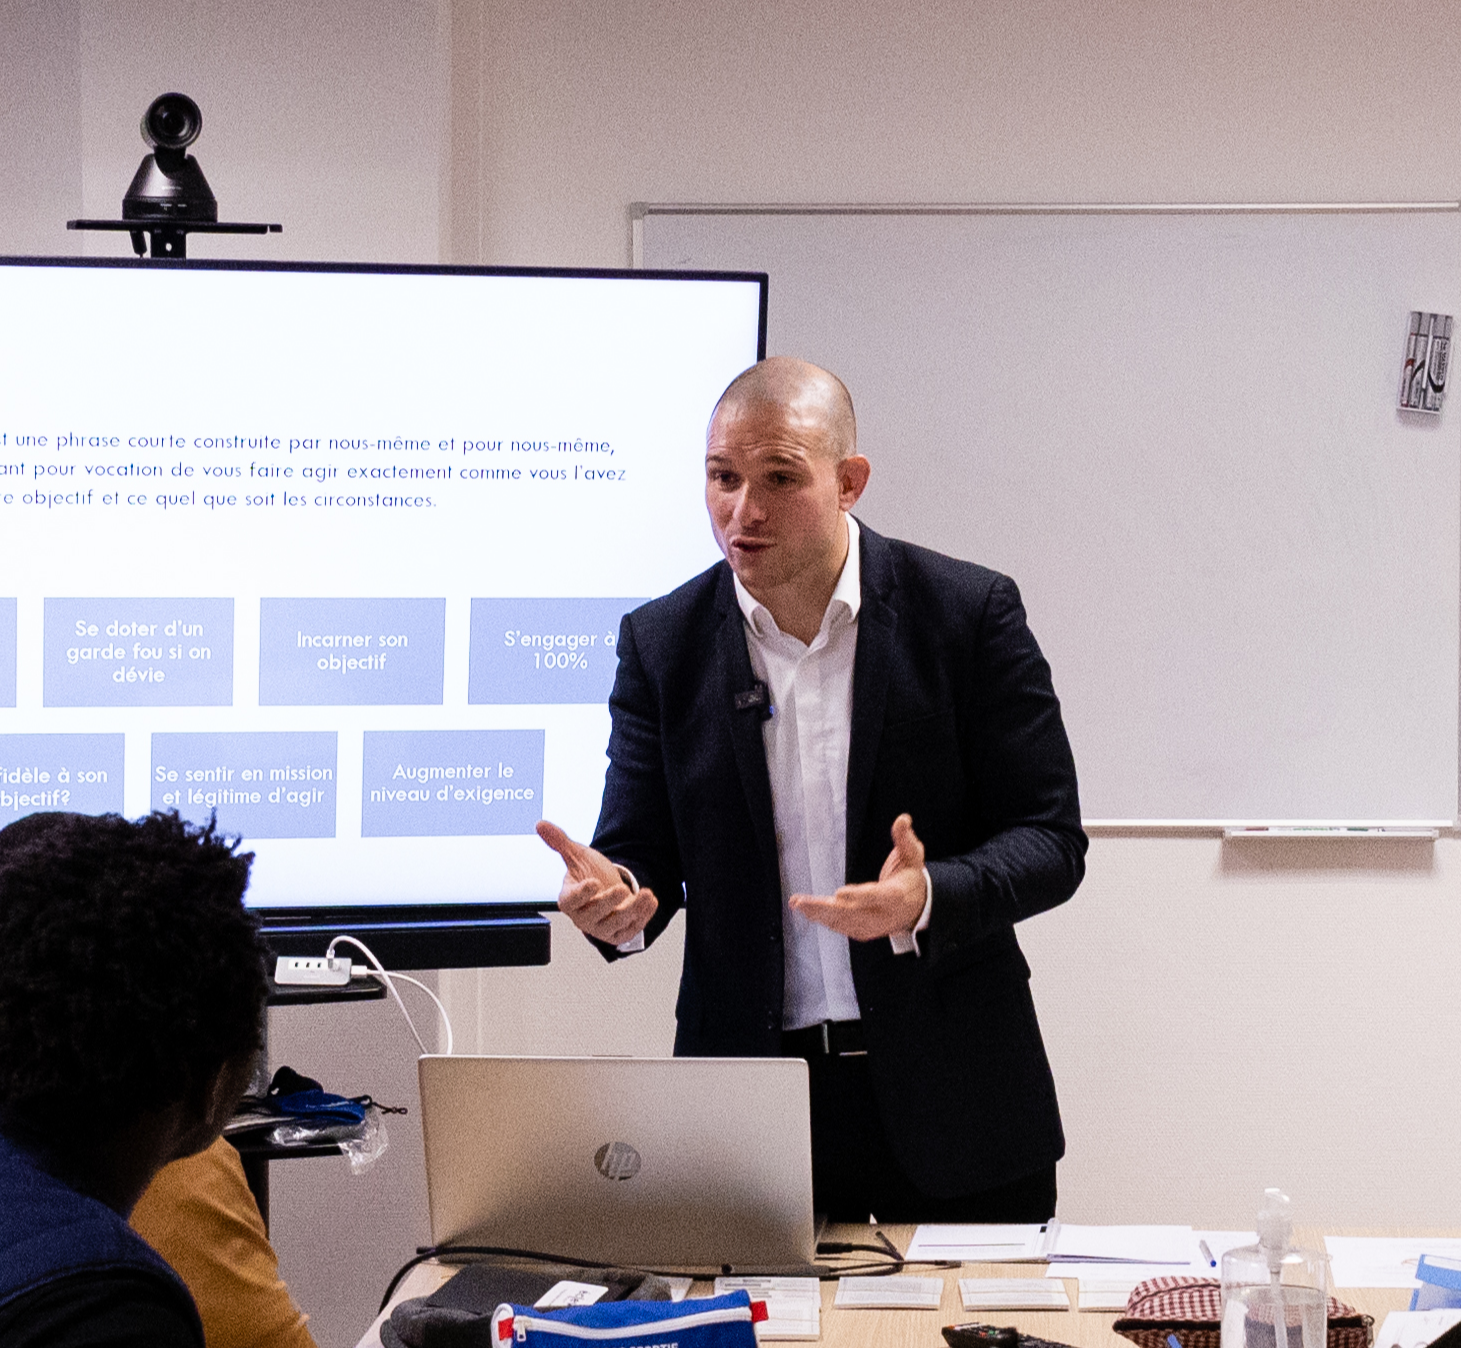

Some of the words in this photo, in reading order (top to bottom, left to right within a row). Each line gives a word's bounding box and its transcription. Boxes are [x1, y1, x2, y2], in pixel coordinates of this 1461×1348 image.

[16, 432, 48, 448] une
[57, 432, 120, 450] phrase
[128, 433, 186, 449] courte
[193, 436, 281, 451] construite
[290, 437, 320, 454] par
[329, 436, 431, 452] nous-même
[438, 437, 455, 452] et
[463, 438, 503, 456] pour
[510, 436, 615, 455] nous-même,
[35, 462, 76, 480] pour
[85, 462, 163, 478] vocation
[171, 462, 195, 479] de
[203, 464, 242, 478] vous
[250, 462, 294, 479] faire
[302, 464, 338, 483] agir
[347, 464, 452, 481] exactement
[460, 466, 522, 482] comme
[530, 467, 568, 482] vous
[574, 466, 626, 482] l'avez
[22, 488, 94, 510] objectif
[102, 491, 119, 507] et
[127, 492, 147, 506] ce
[156, 490, 196, 510] quel
[204, 493, 237, 510] que
[245, 493, 274, 508] soit
[284, 491, 307, 507] les
[314, 492, 437, 509] circonstances.
[75, 620, 99, 637] Se
[106, 620, 157, 637] doter
[164, 620, 203, 637] d'un
[297, 630, 372, 648] Incarner
[378, 633, 408, 648] son
[503, 630, 597, 651] S'engager
[604, 629, 616, 648] à
[66, 643, 125, 664] garde
[132, 643, 162, 660] fou
[169, 643, 182, 660] si
[189, 646, 211, 660] on
[533, 653, 588, 670] 100%
[317, 653, 387, 675] objectif
[112, 666, 165, 683] dévie
[57, 767, 70, 784] à
[77, 770, 108, 784] son
[155, 766, 179, 783] Se
[185, 766, 235, 783] sentir
[241, 767, 263, 782] en
[270, 765, 333, 782] mission
[393, 763, 491, 784] Augmenter
[498, 761, 514, 779] le
[162, 790, 181, 806] et
[187, 789, 262, 809] légitime
[268, 787, 324, 807] d'agir
[370, 786, 430, 802] niveau
[436, 785, 535, 805] d'exigence
